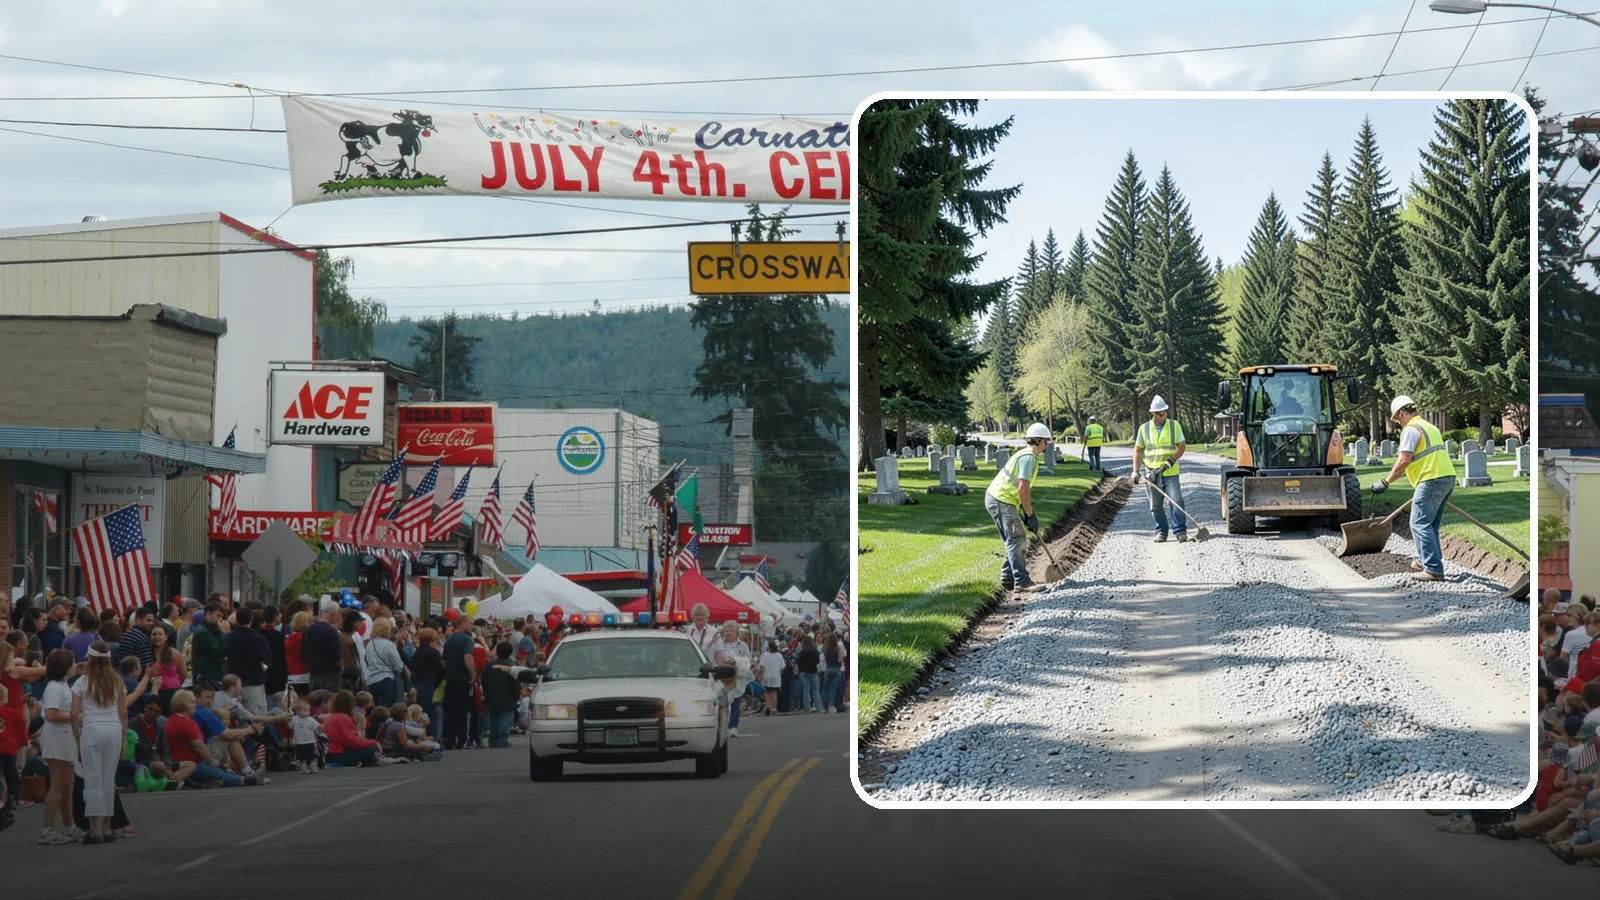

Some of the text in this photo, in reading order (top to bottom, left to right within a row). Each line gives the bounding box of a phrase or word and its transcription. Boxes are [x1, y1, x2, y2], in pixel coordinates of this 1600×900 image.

[481, 141, 605, 192] JULY
[632, 150, 746, 197] 4th.
[697, 254, 850, 280] CROSSWA
[283, 380, 374, 420] ACE
[405, 409, 453, 422] CEDAR
[283, 421, 371, 437] Hardware
[416, 428, 477, 447] Coca-Cola
[353, 467, 386, 480] Simpl
[95, 485, 124, 495] Vincent
[126, 486, 136, 495] de
[137, 486, 155, 495] Paul
[81, 503, 154, 522] THT
[212, 516, 330, 536] HARDARE
[688, 526, 741, 535] CRNATION
[699, 535, 730, 543] GLASS
